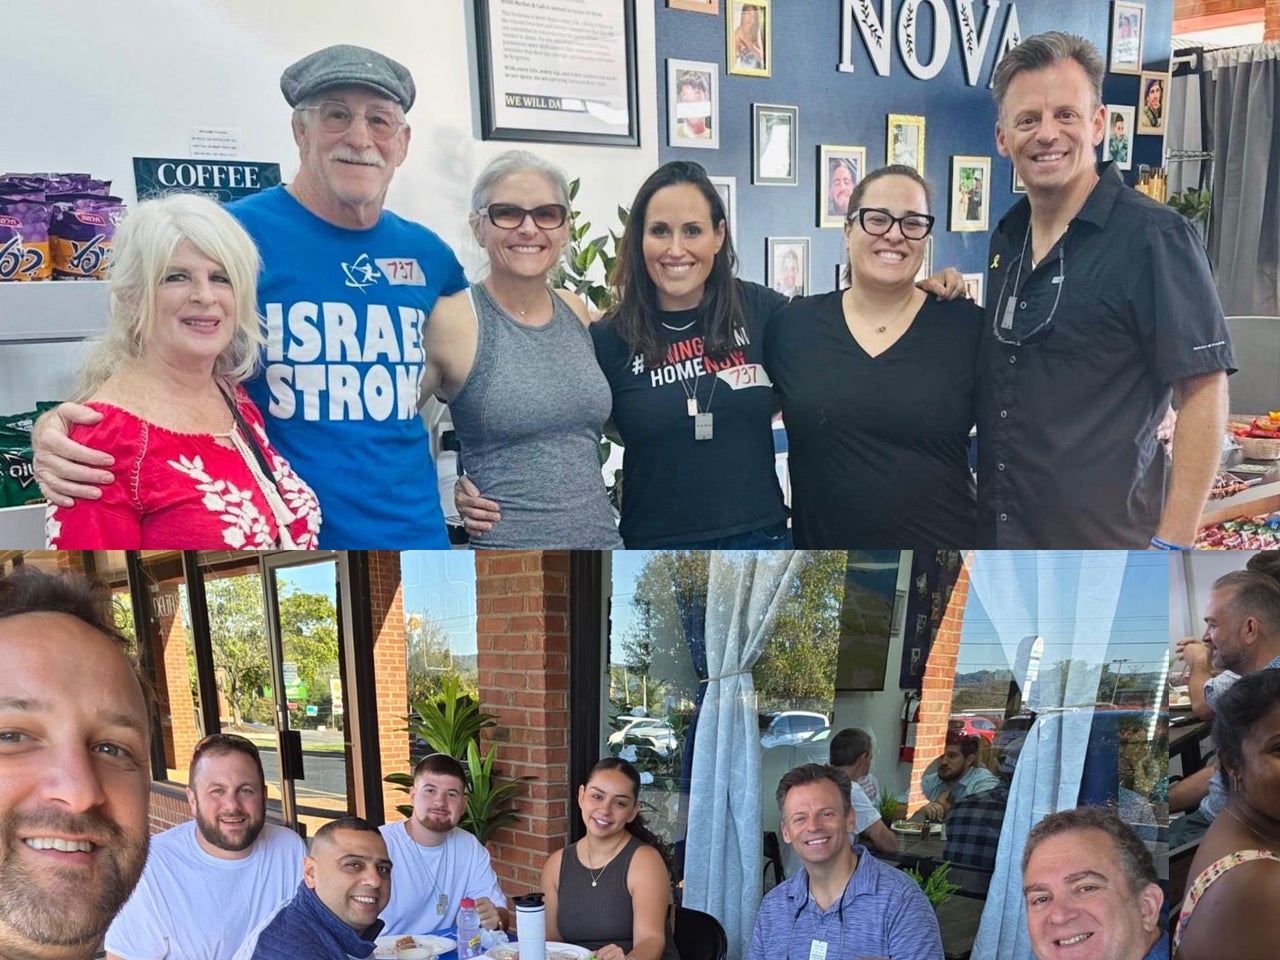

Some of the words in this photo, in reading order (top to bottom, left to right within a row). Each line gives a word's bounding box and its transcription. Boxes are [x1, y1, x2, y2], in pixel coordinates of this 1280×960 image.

[505, 95, 522, 107] WE
[523, 97, 547, 109] WILL
[157, 163, 261, 189] COFFEE
[387, 262, 414, 280] 737
[729, 366, 757, 385] 737
[265, 363, 426, 421] STRON
